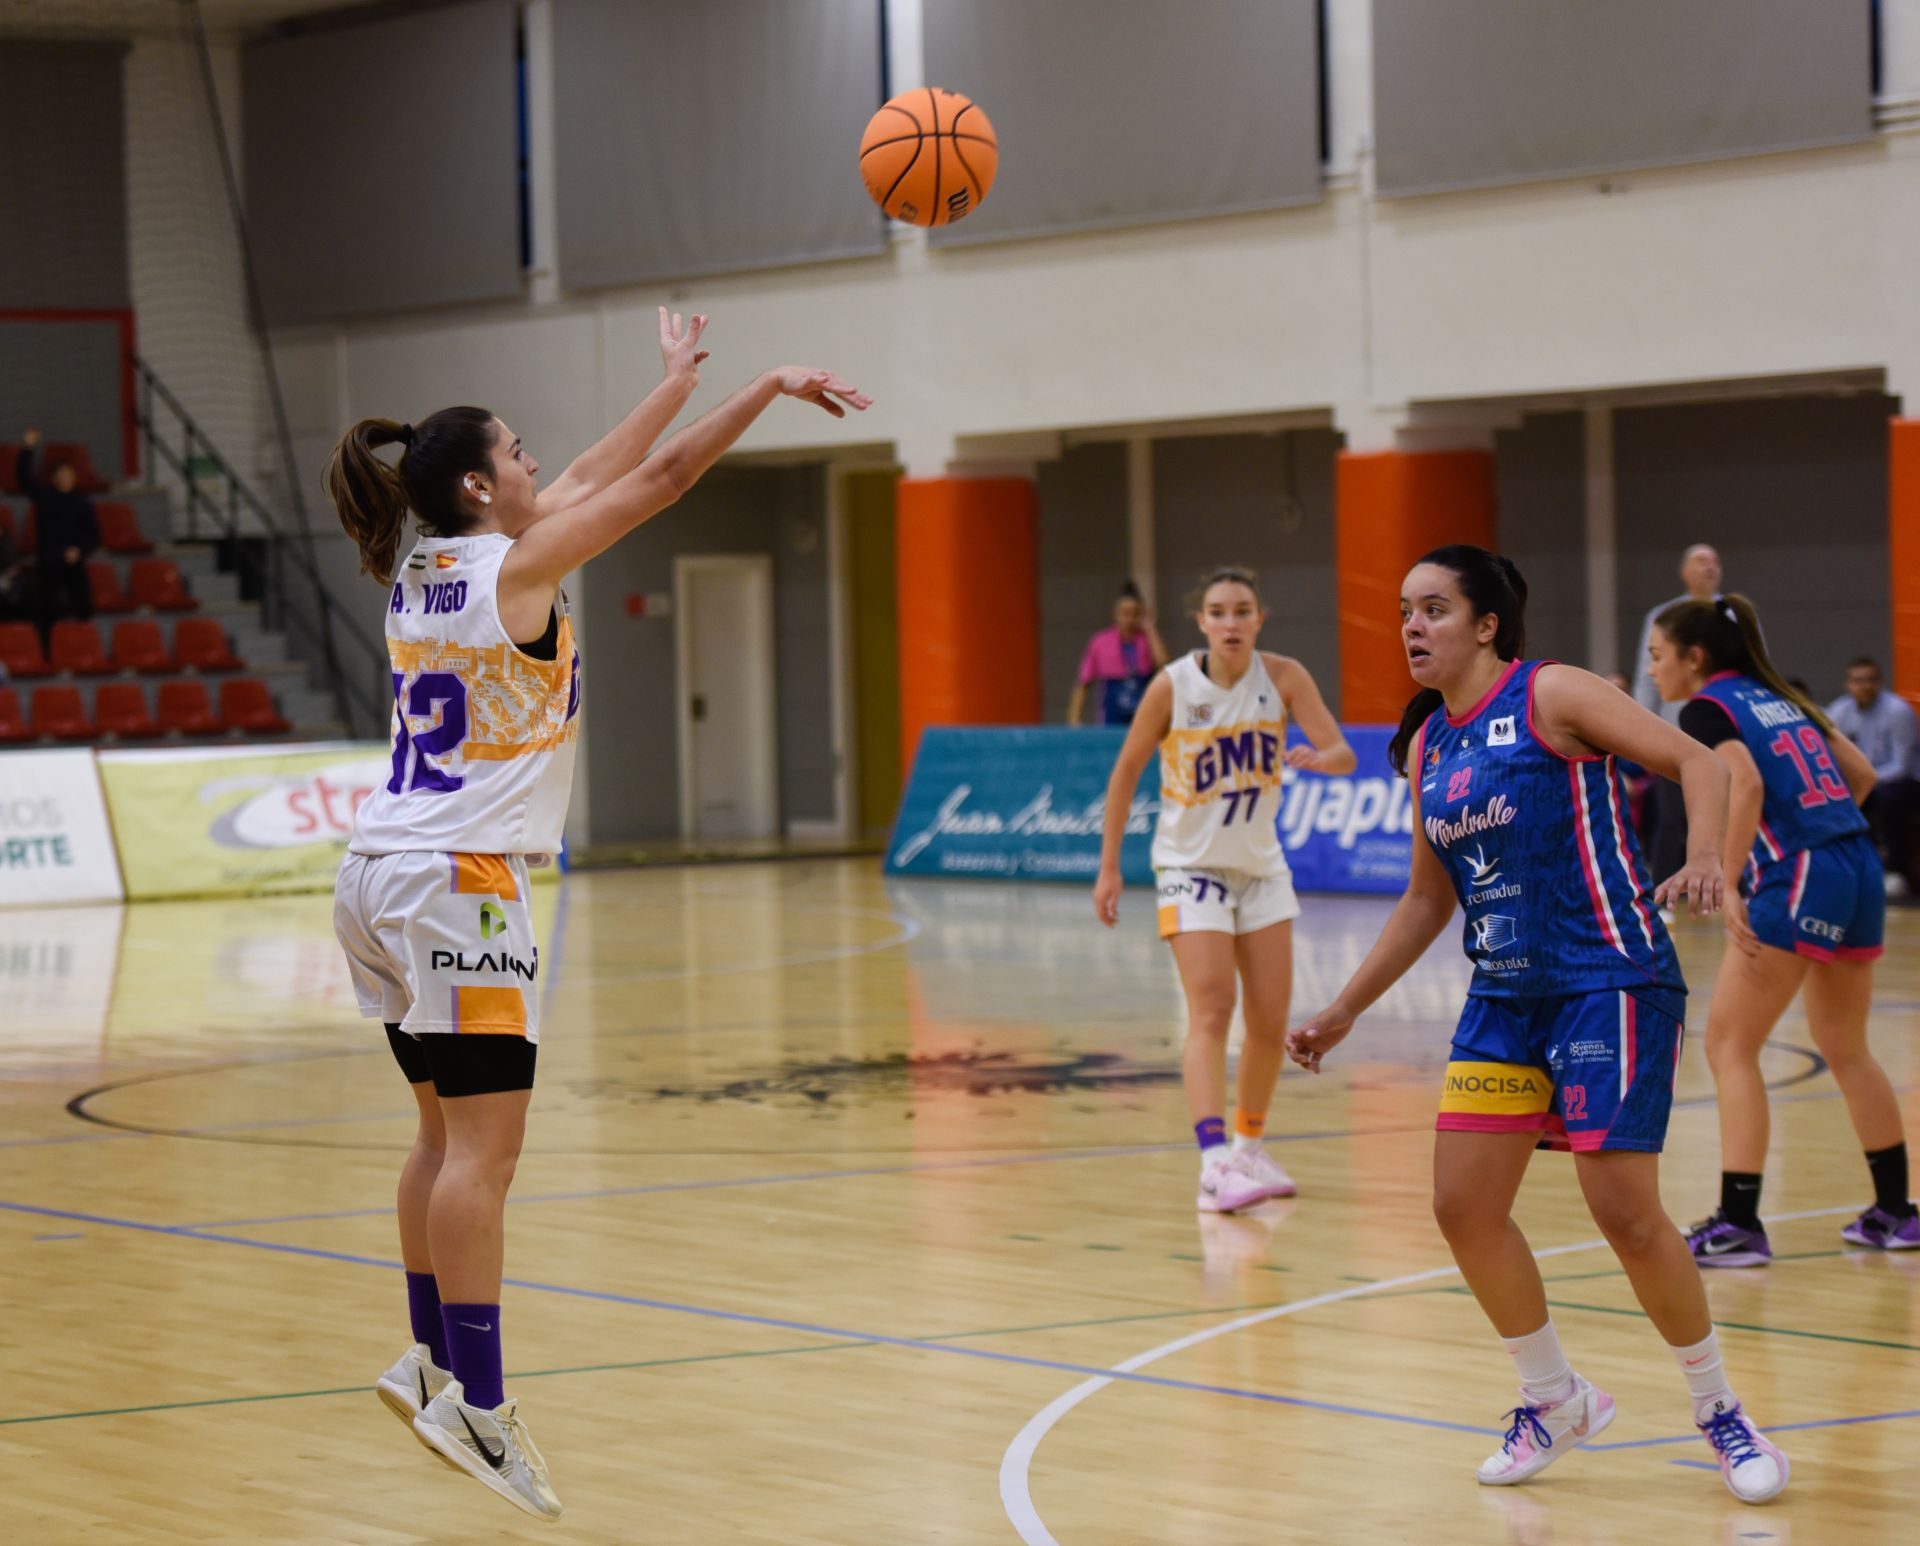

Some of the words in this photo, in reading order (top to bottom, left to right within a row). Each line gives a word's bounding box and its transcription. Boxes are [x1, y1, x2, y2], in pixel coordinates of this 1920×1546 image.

[422, 580, 468, 615] VIGO
[1446, 766, 1473, 804] 22
[1770, 726, 1850, 809] 13
[894, 784, 1003, 868] Juan
[1221, 787, 1261, 827] 77
[1425, 794, 1518, 849] Miralvalle
[1190, 877, 1228, 904] 77
[1563, 1085, 1588, 1121] 22
